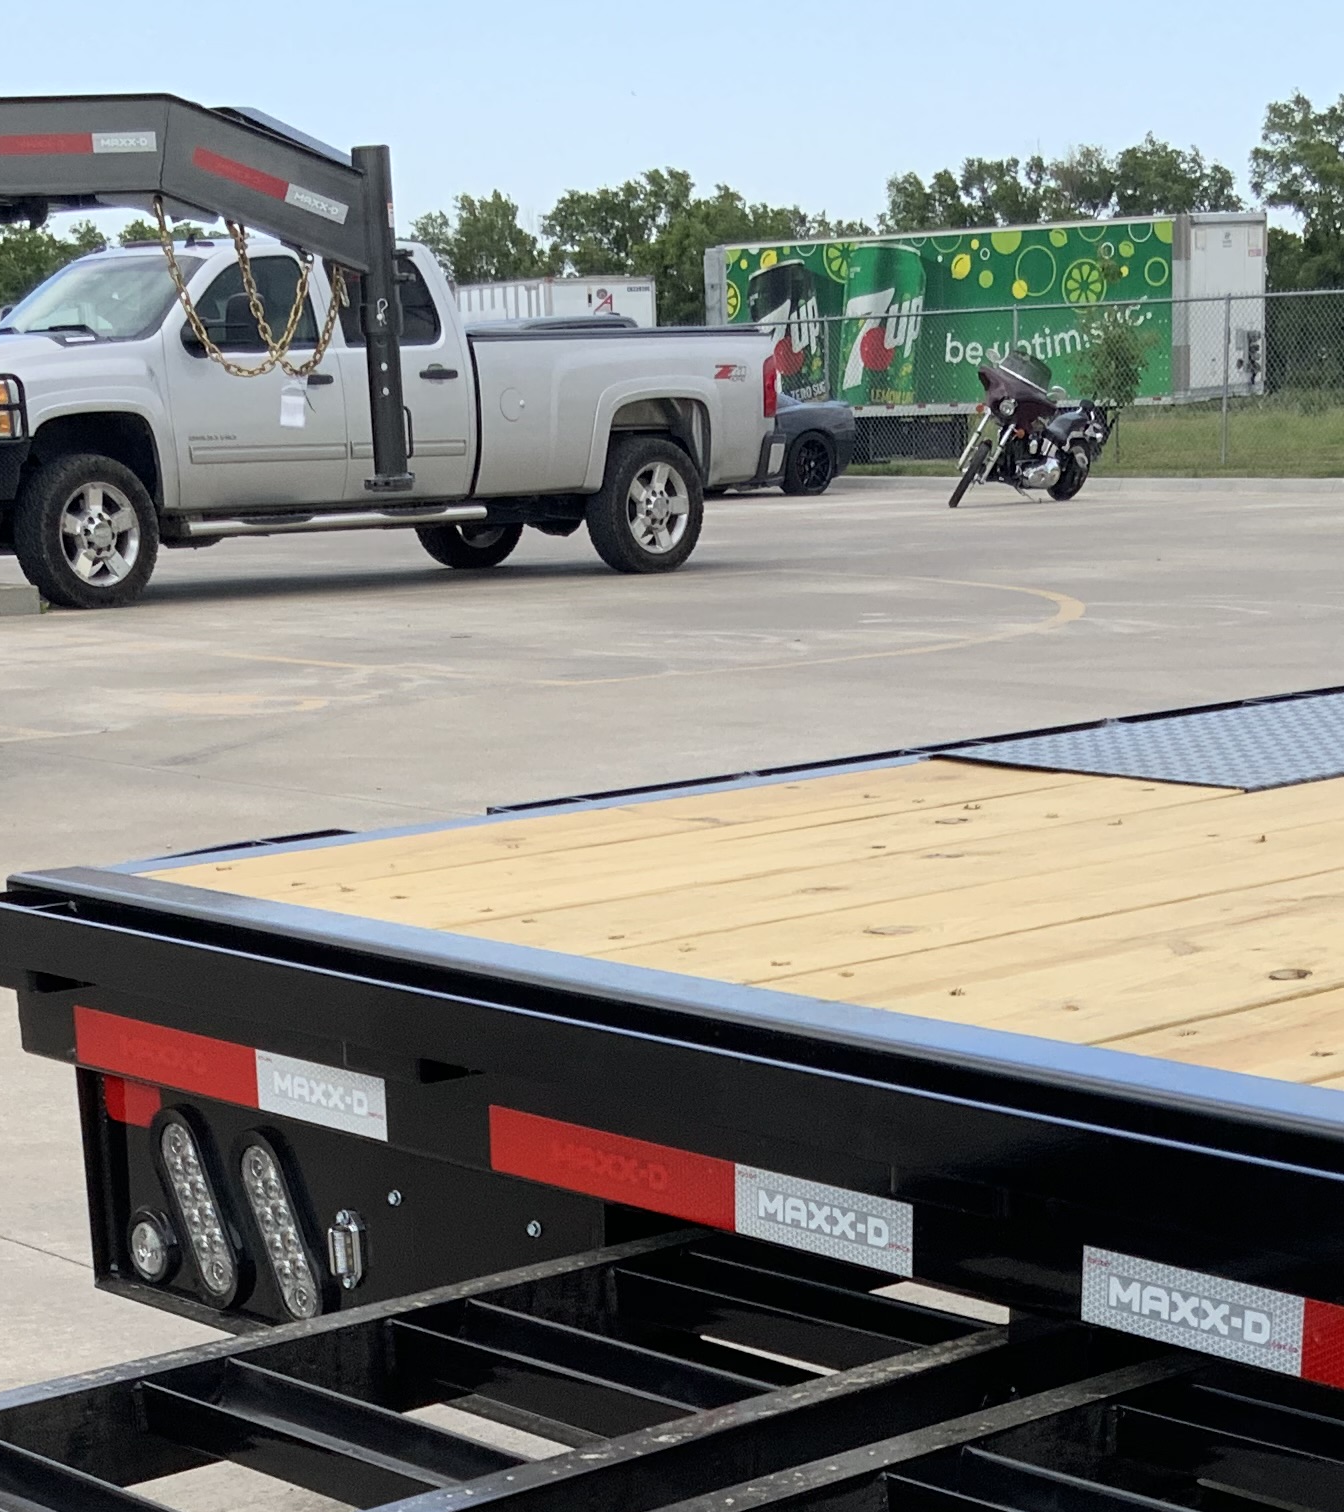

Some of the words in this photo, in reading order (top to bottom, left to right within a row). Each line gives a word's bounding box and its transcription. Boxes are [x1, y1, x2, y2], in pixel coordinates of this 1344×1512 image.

[100, 137, 148, 148] MAXX-D
[945, 332, 984, 365] be
[273, 1071, 369, 1116] MAXX-D
[757, 1189, 889, 1249] MAXX-D
[1109, 1275, 1271, 1345] MAXX-D
